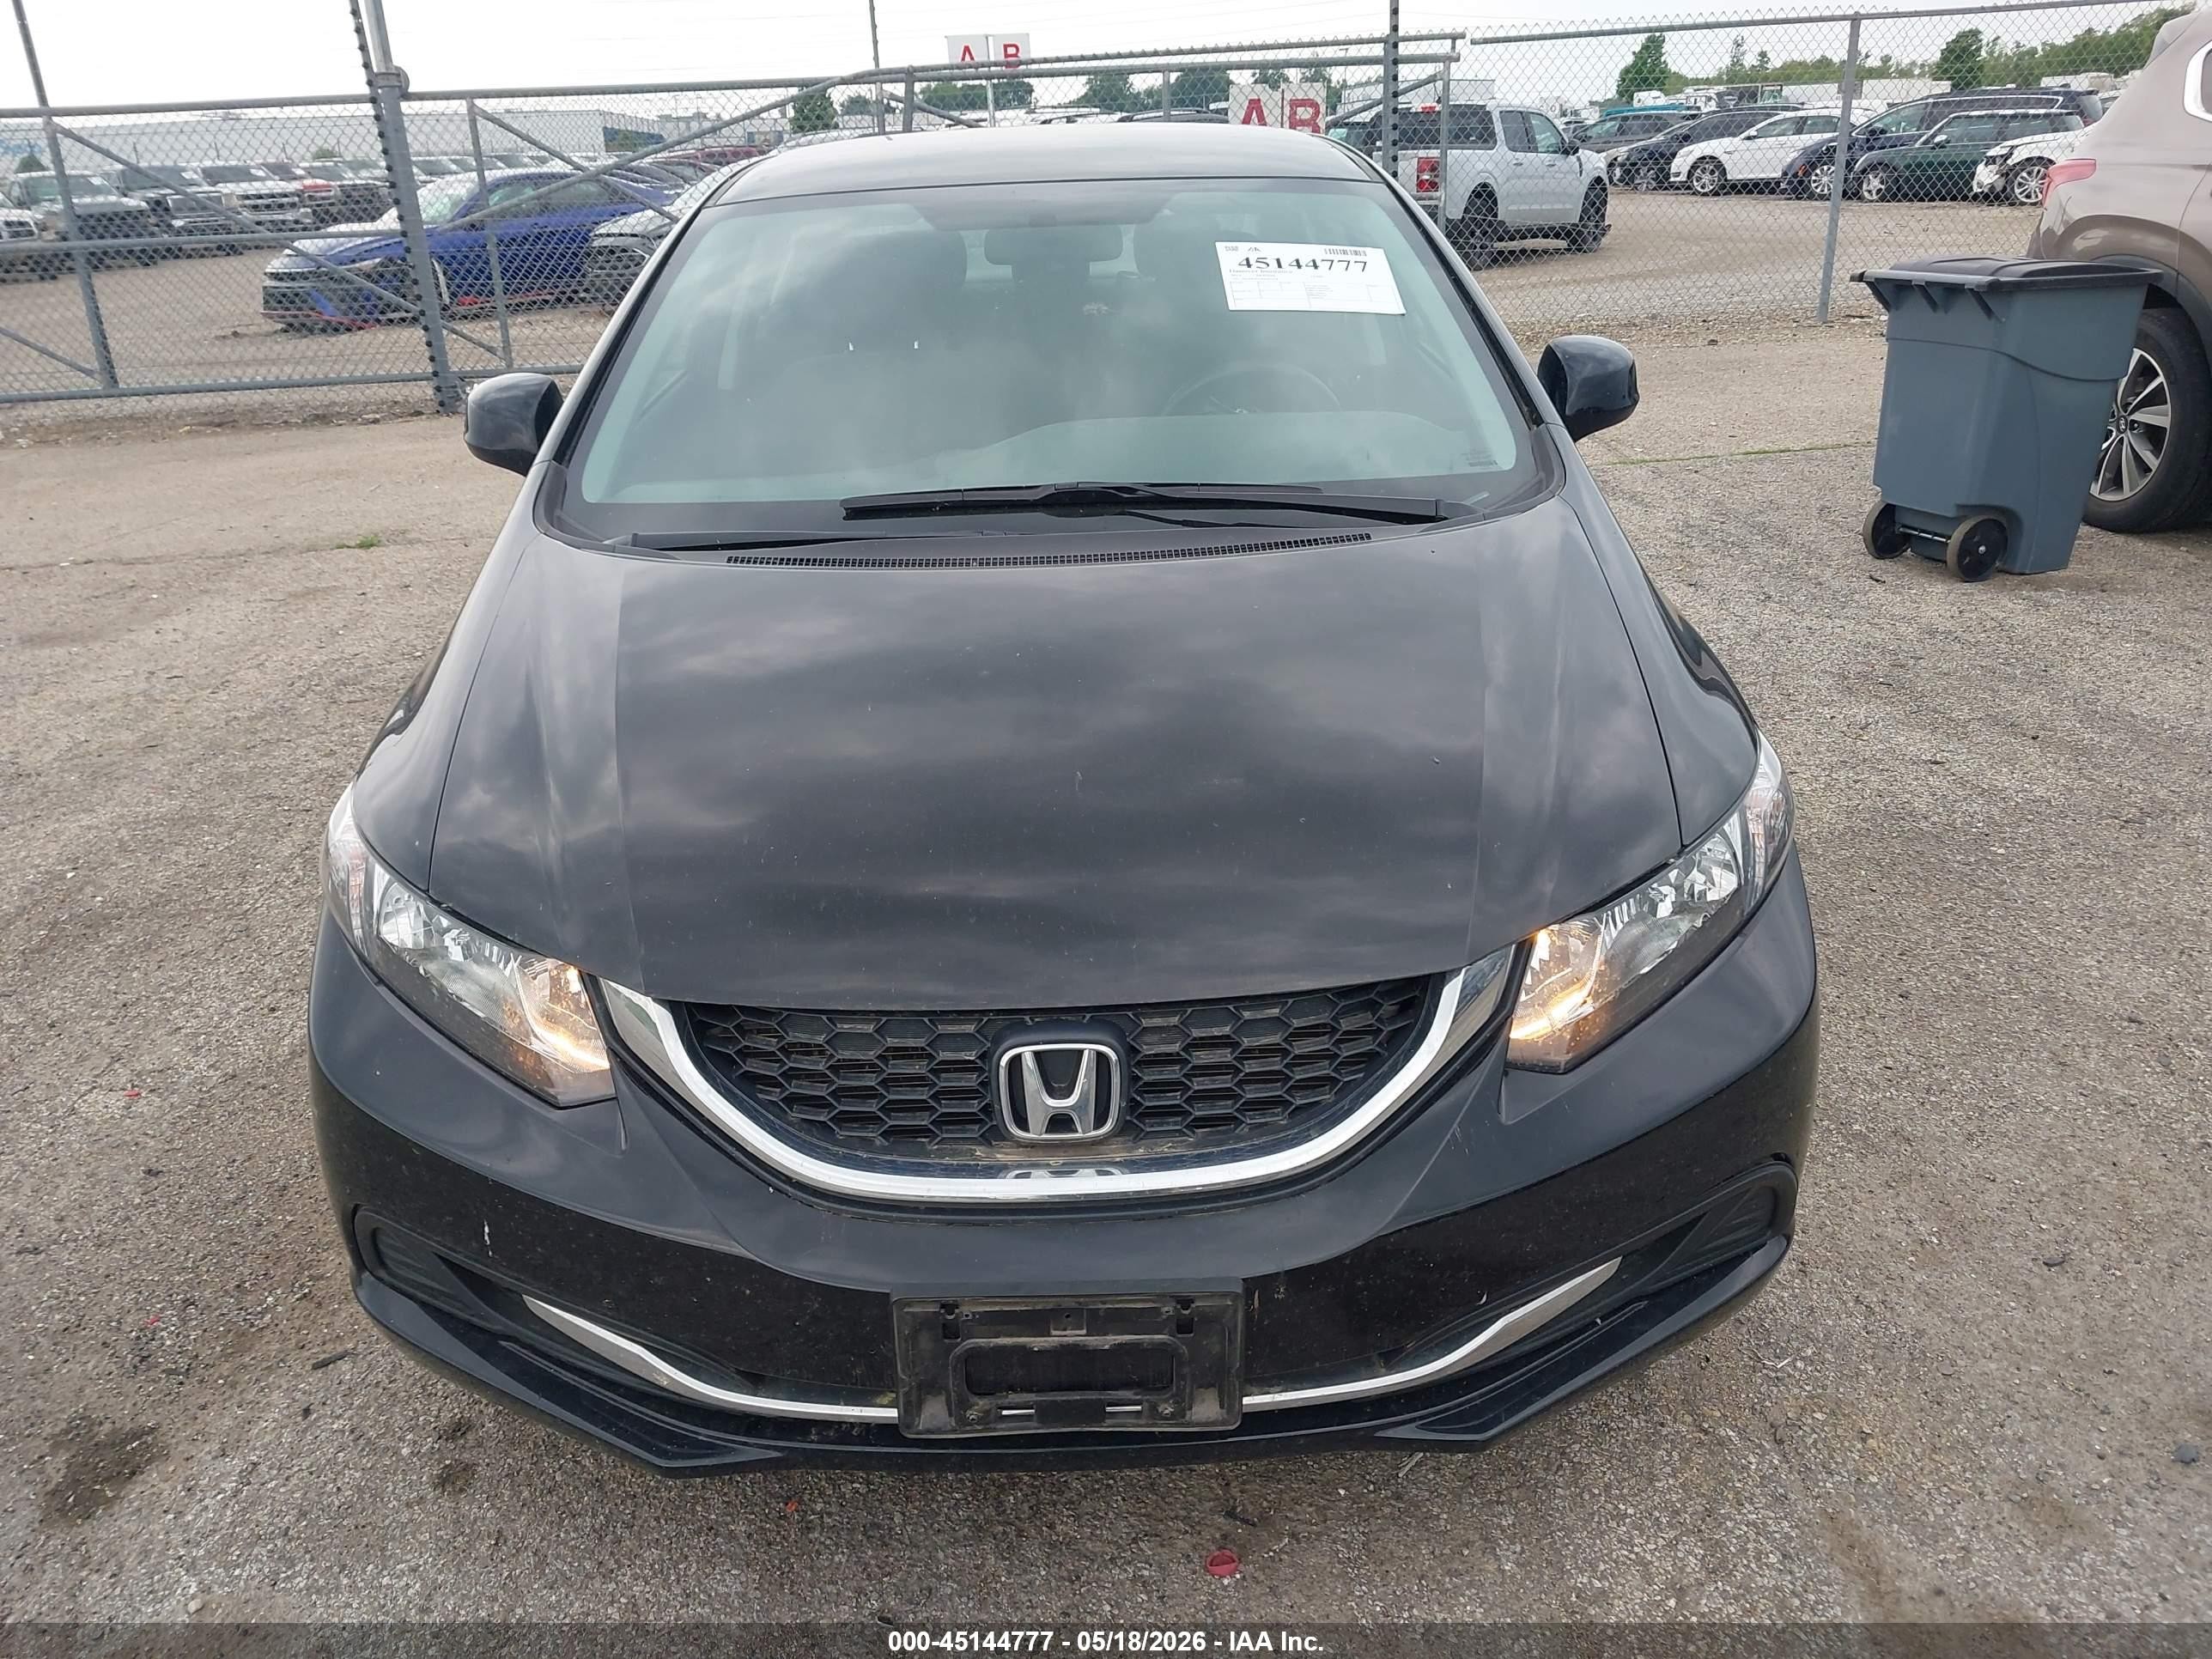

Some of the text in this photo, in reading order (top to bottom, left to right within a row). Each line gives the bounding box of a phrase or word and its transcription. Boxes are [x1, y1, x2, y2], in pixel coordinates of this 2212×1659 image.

[961, 45, 975, 61] A
[1003, 43, 1020, 69] B
[1242, 98, 1267, 126] A
[1289, 98, 1321, 134] B
[1237, 257, 1368, 273] 45144777
